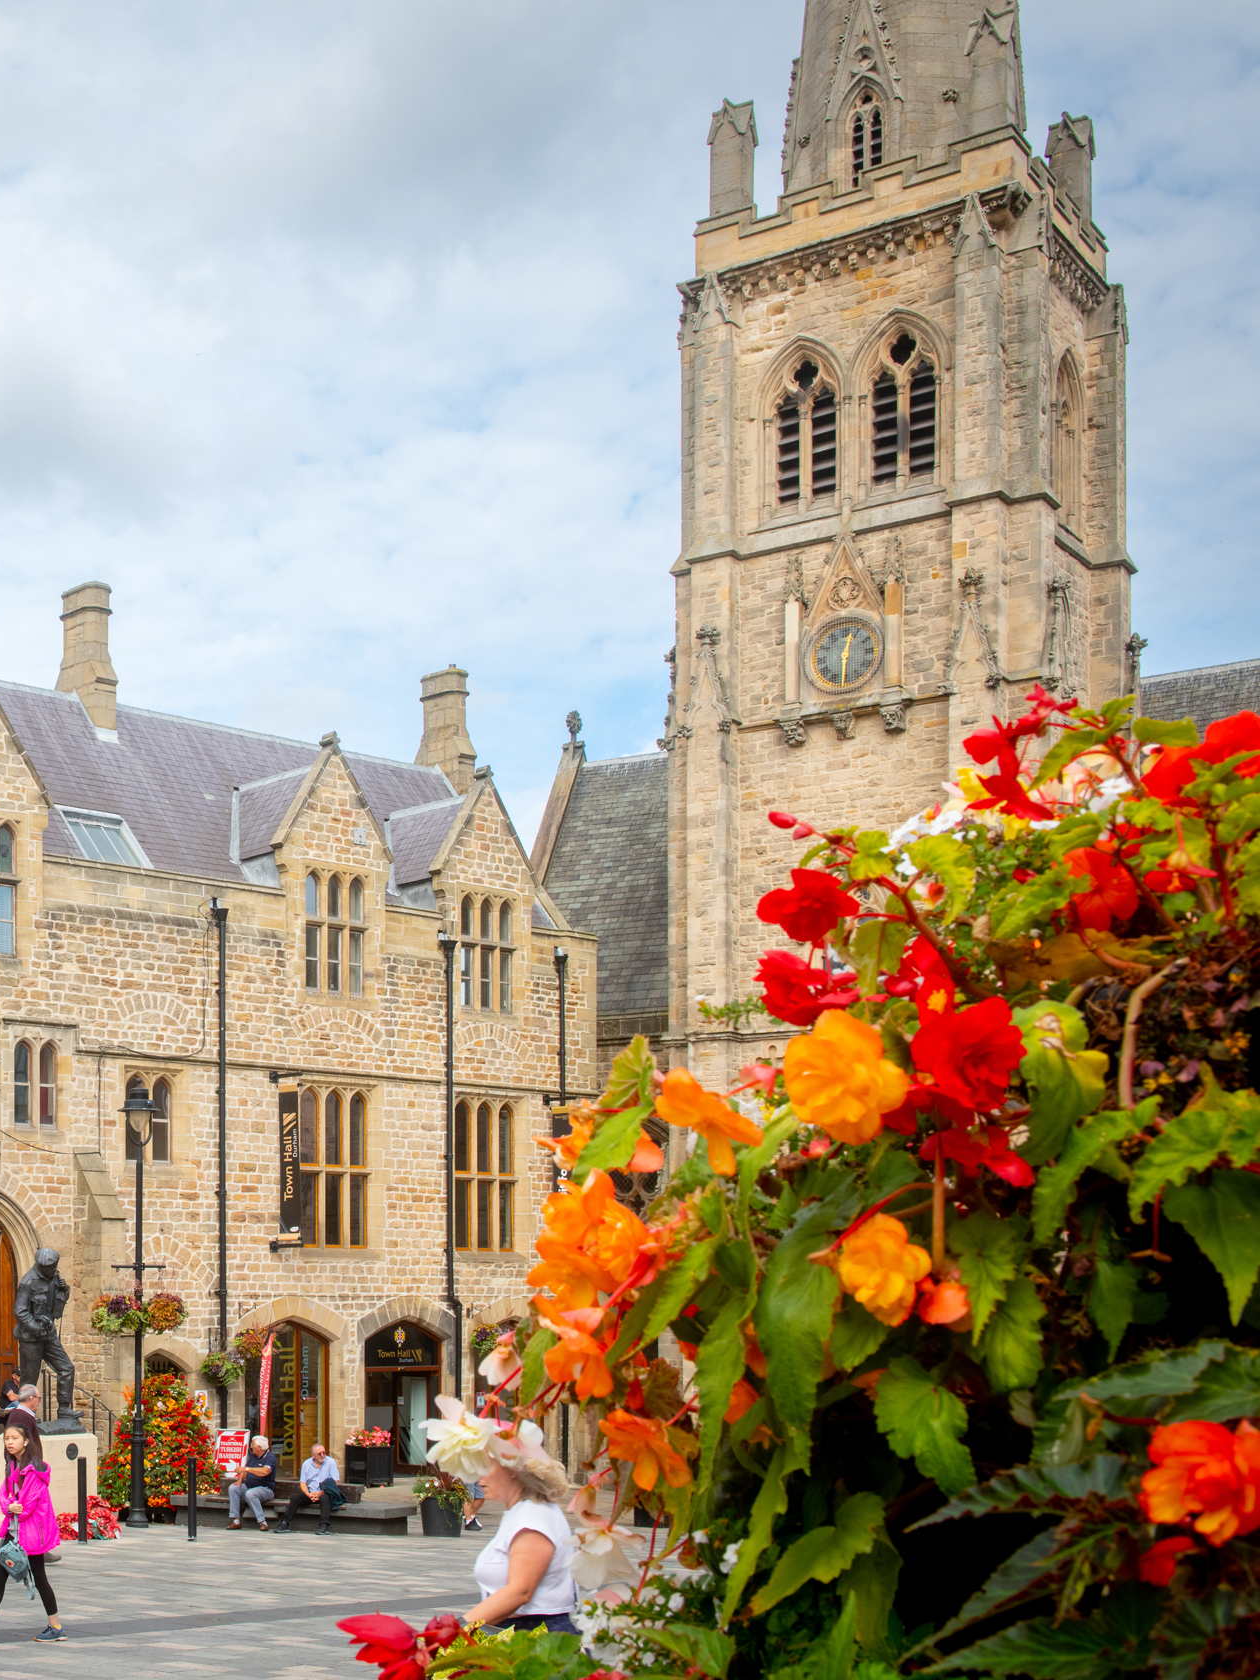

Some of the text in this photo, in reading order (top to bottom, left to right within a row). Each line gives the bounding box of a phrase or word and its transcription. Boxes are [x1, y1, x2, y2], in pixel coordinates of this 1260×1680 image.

[284, 1135, 293, 1202] Town Hall
[300, 1345, 309, 1397] Durham
[377, 1349, 411, 1358] Town Hall
[260, 1383, 268, 1417] MARKET
[279, 1346, 295, 1467] Town Hall
